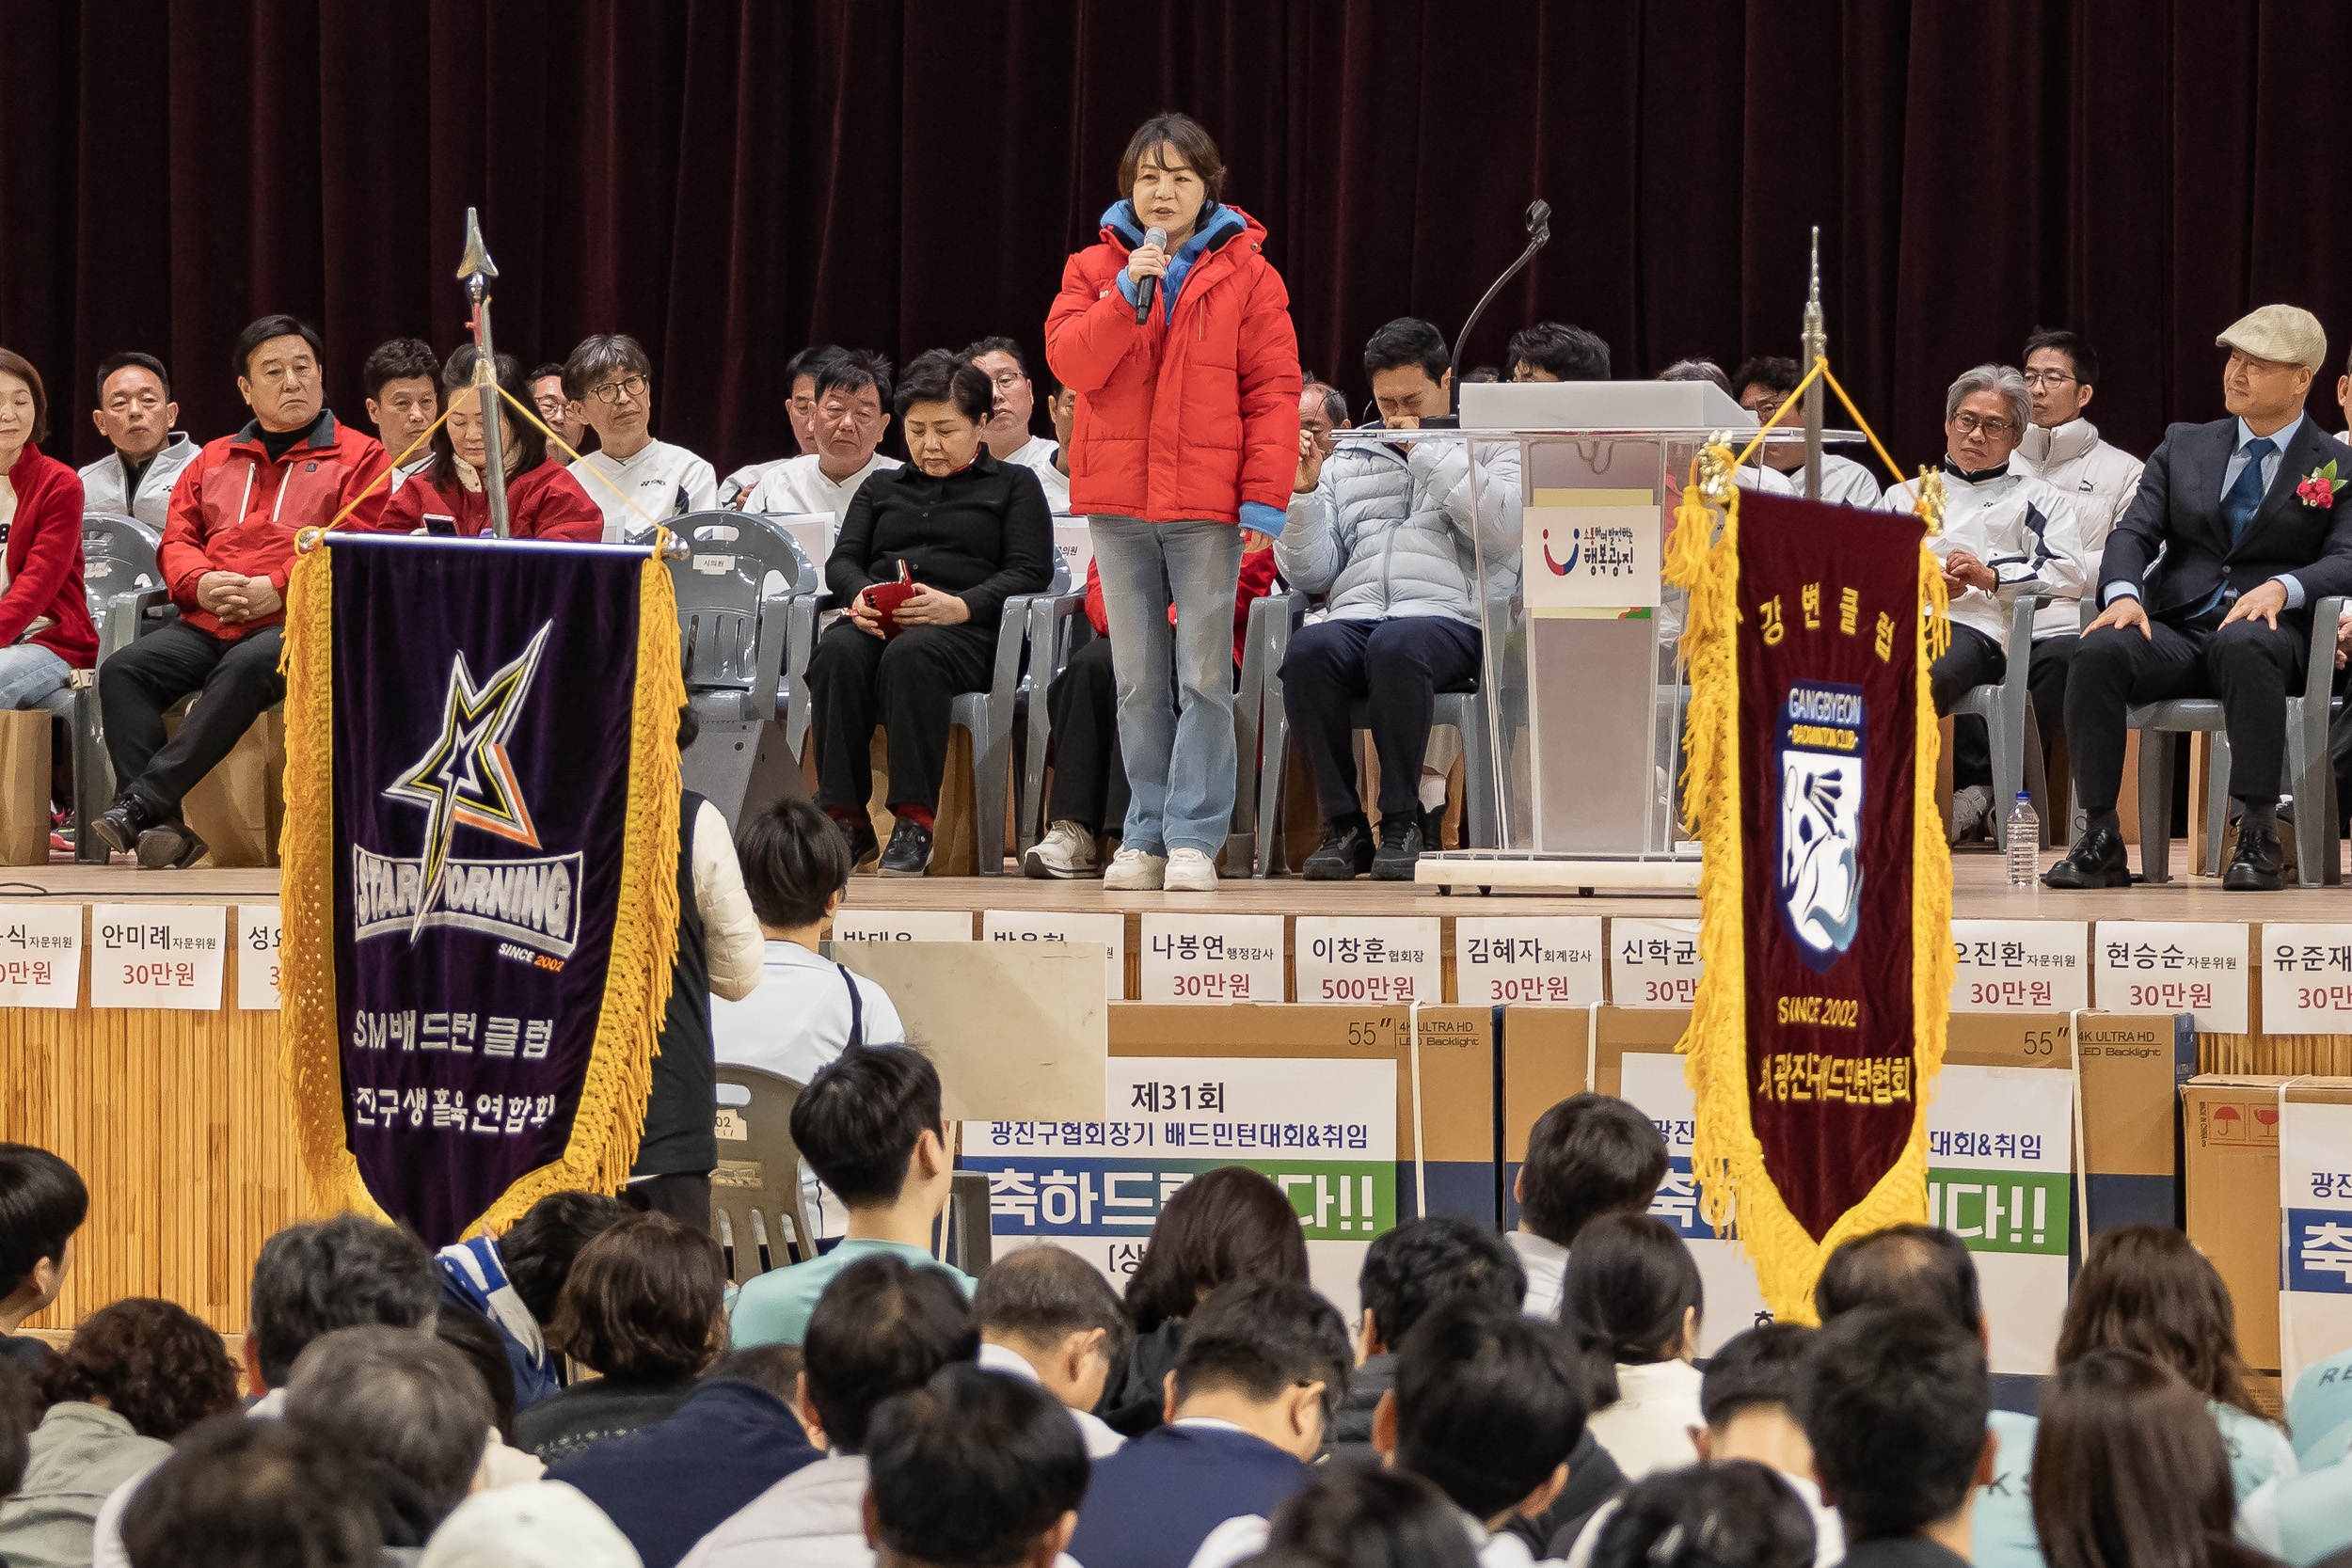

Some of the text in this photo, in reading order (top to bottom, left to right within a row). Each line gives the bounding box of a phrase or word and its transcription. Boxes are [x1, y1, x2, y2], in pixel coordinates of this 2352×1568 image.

[1058, 546, 1079, 557] 의원
[1583, 544, 1633, 577] 행복광진
[0, 924, 27, 950] 식
[102, 924, 217, 951] 안미례 자문위원
[1152, 933, 1275, 961] 나봉연 행정감사
[1312, 937, 1425, 964] 이창훈 협회장
[499, 942, 535, 963] SINCE
[1467, 938, 1593, 965] 김혜자 회계감사
[2026, 954, 2076, 968] 자문위원
[2106, 942, 2237, 970] 현승순 자문위원
[2273, 944, 2352, 973] 유준재
[122, 961, 196, 988] 30만원
[1173, 973, 1251, 1000] 30만원
[1321, 975, 1415, 1004] 500만원
[1490, 975, 1569, 1003] 30만원
[1970, 980, 2052, 1006] 30만원
[2129, 982, 2212, 1009] 30만원
[1820, 997, 1859, 1029] 2002
[1417, 1021, 1457, 1033] ULTRA
[1457, 1021, 1473, 1033] HD
[2095, 1031, 2135, 1042] ULTRA
[2137, 1031, 2155, 1042] HD
[1426, 1037, 1480, 1048] Backlight
[2106, 1047, 2162, 1058] Backlight
[1131, 1081, 1225, 1114] 제31회
[990, 1120, 1368, 1149] 광진구협회장기 배드민턴대회&취임
[1930, 1131, 2042, 1160] 대회&취임
